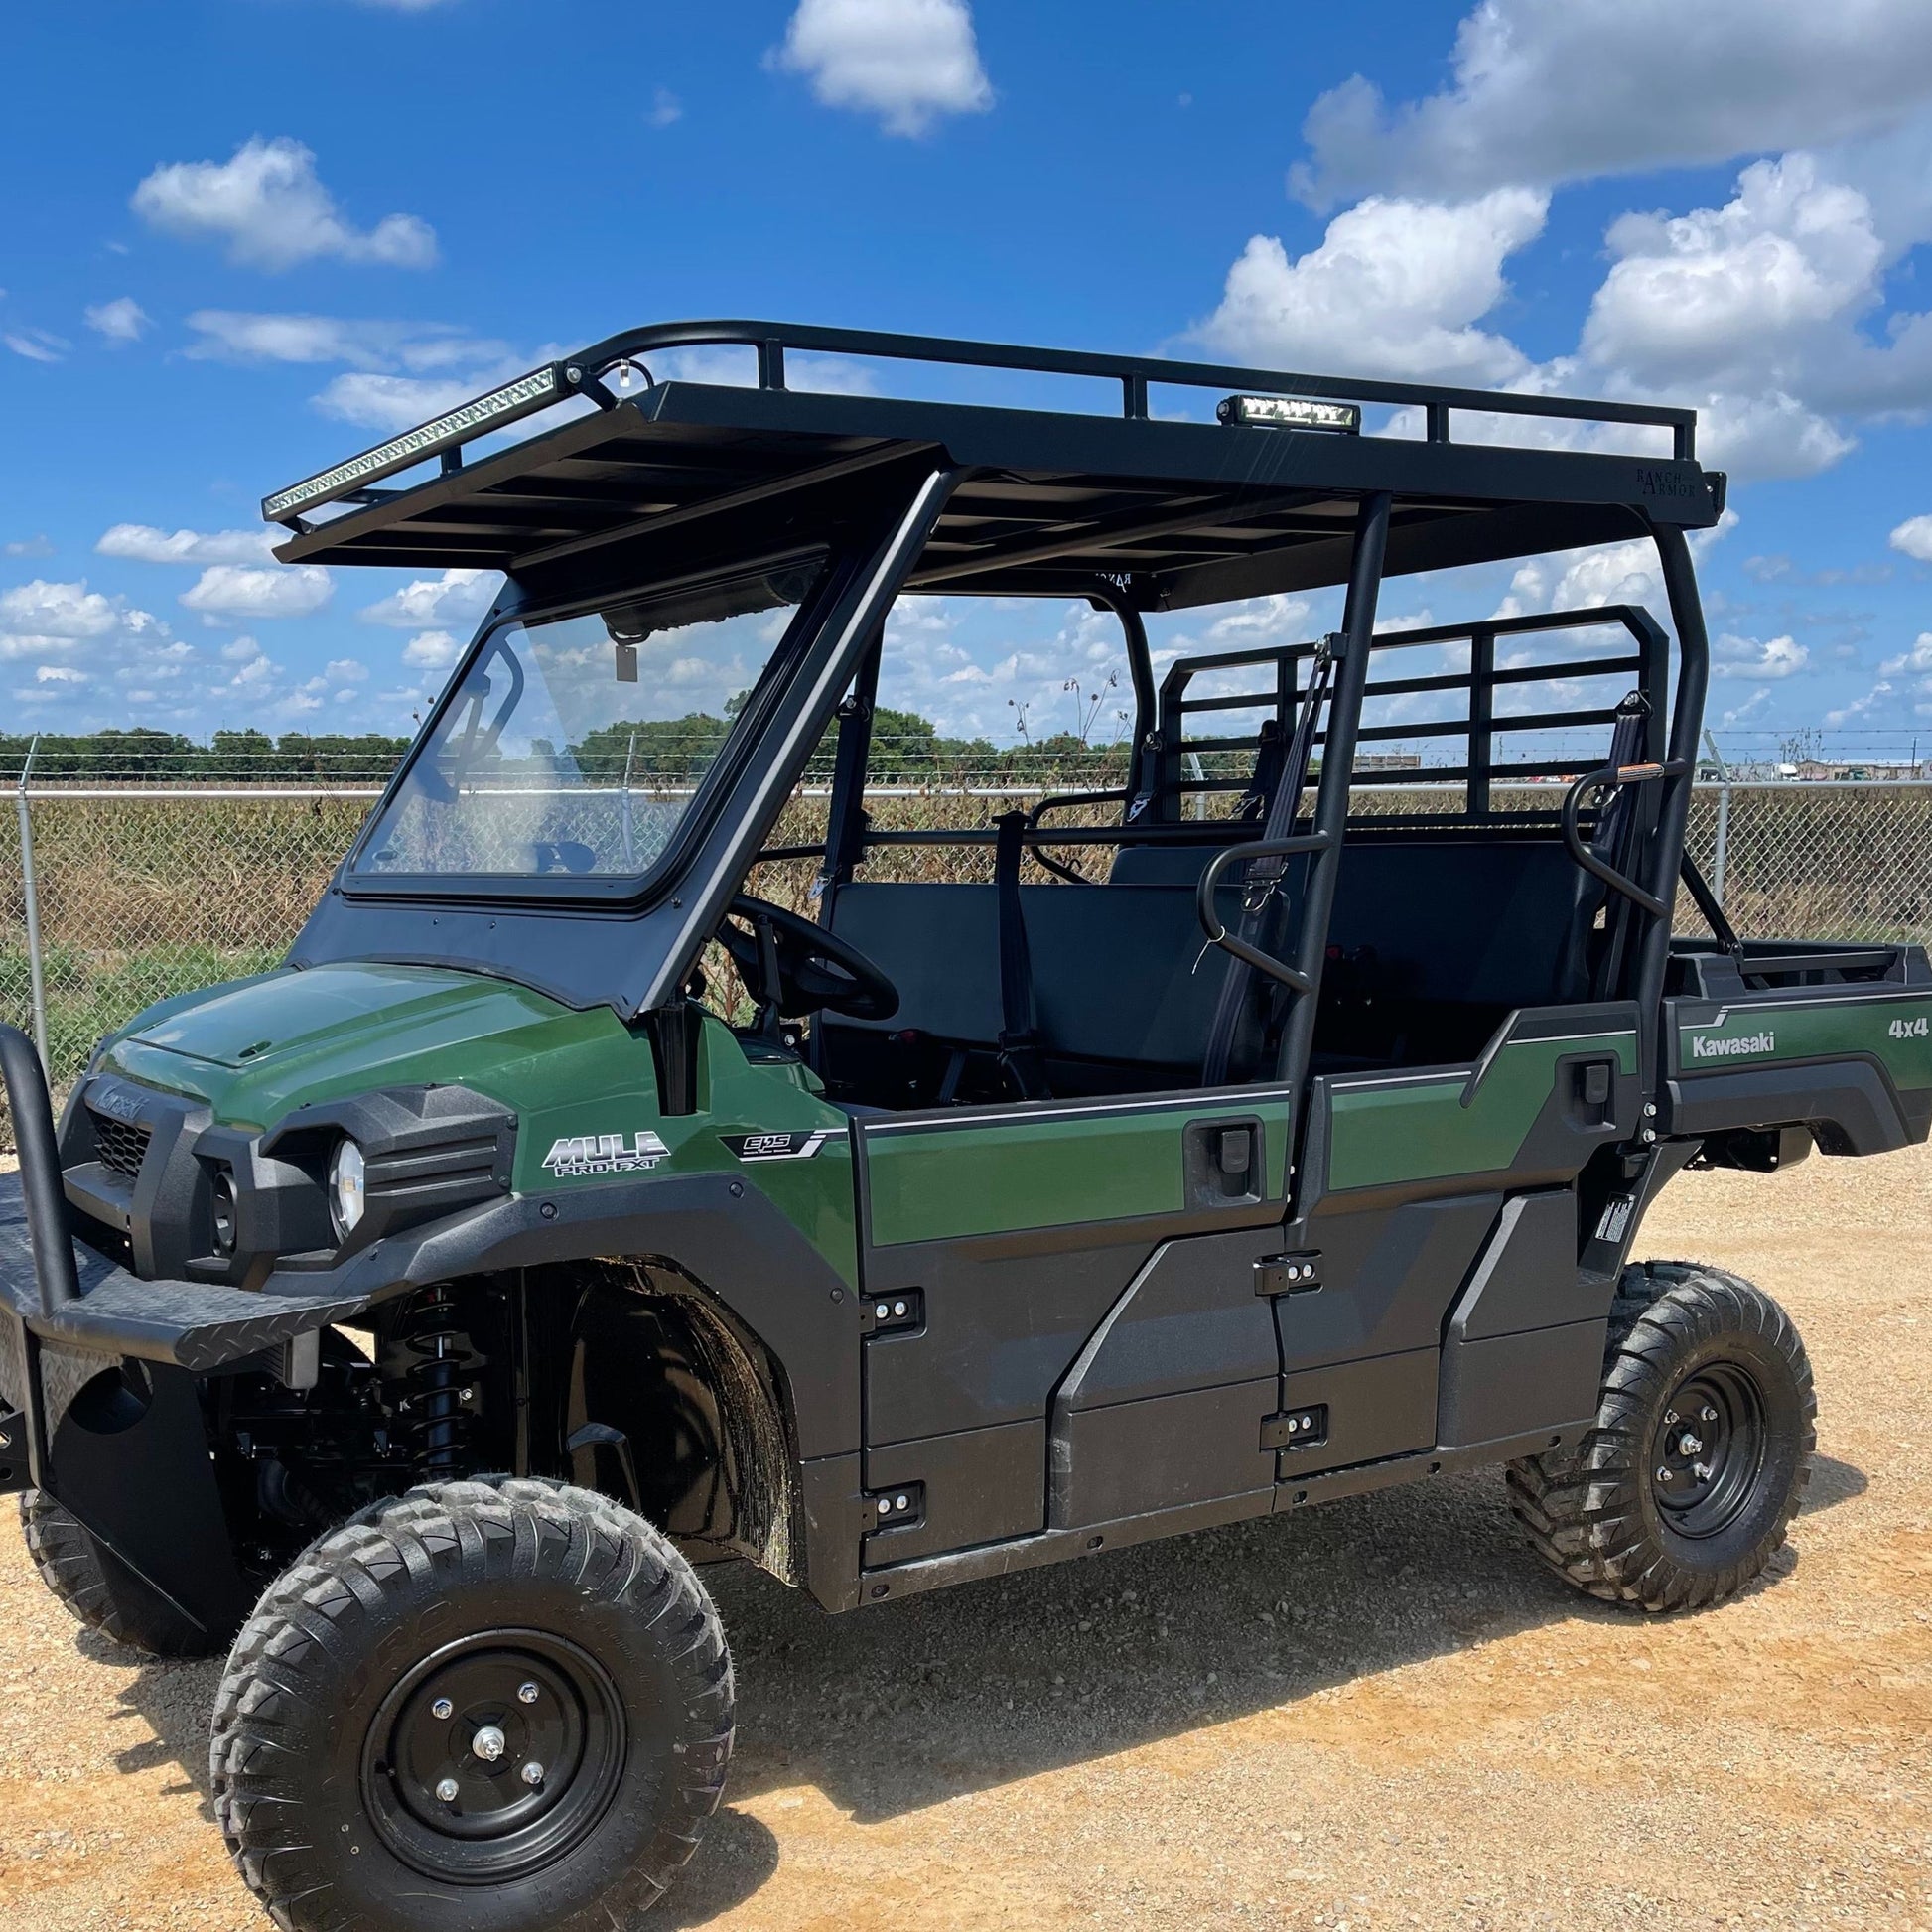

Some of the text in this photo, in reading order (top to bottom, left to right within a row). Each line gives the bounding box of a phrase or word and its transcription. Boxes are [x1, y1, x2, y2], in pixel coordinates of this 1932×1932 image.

[1636, 469, 1681, 488] RANCH
[1888, 1017, 1929, 1039] 4x4
[1692, 1032, 1775, 1058] Kawasaki
[541, 1130, 672, 1168] MULE
[742, 1134, 792, 1152] EPS
[553, 1157, 661, 1178] PRO-FXT
